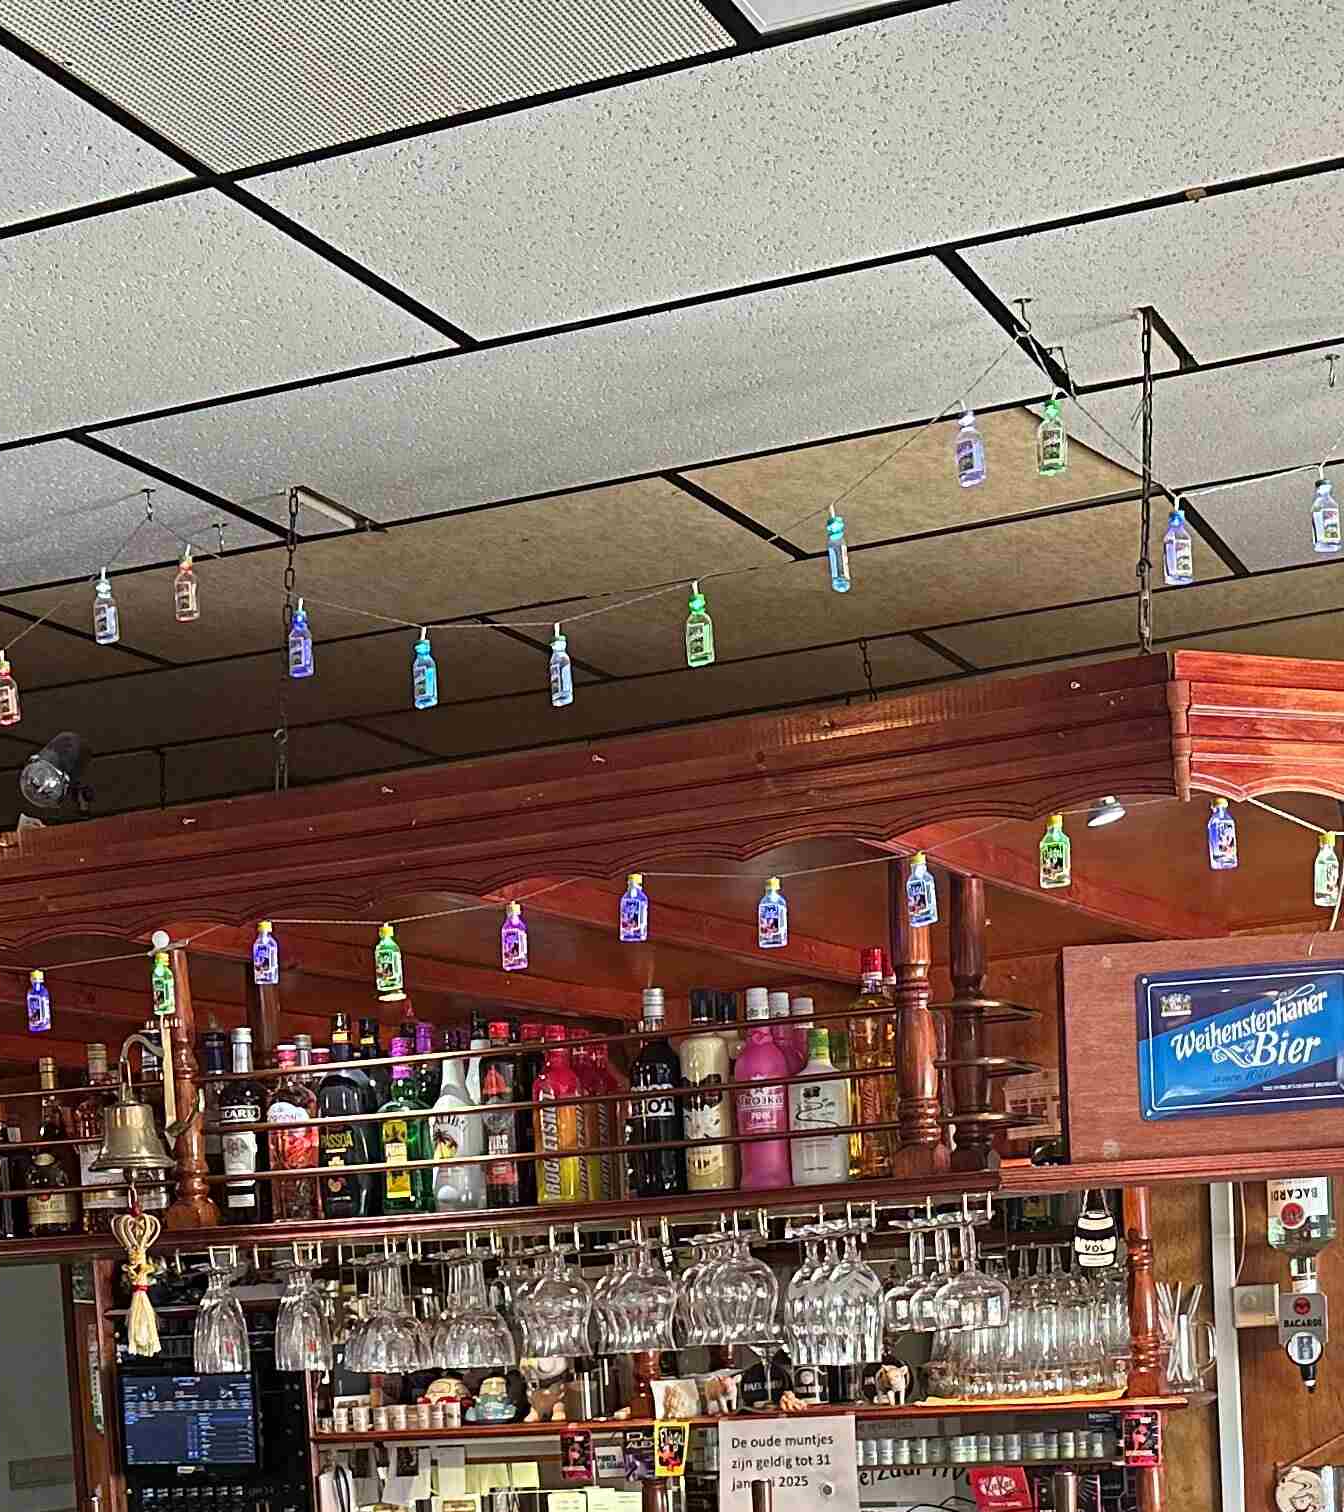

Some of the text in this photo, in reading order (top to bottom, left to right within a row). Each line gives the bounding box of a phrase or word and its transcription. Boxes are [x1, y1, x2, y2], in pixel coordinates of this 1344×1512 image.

[1170, 984, 1328, 1062] Weihenstephaner
[1253, 1030, 1322, 1067] Bier
[1270, 1187, 1318, 1201] BACARDI
[1283, 1319, 1322, 1329] BACARDI
[731, 1434, 834, 1448] De oude muntjes
[731, 1454, 831, 1472] zijn geldig tot 31
[731, 1475, 809, 1491] jani 2025
